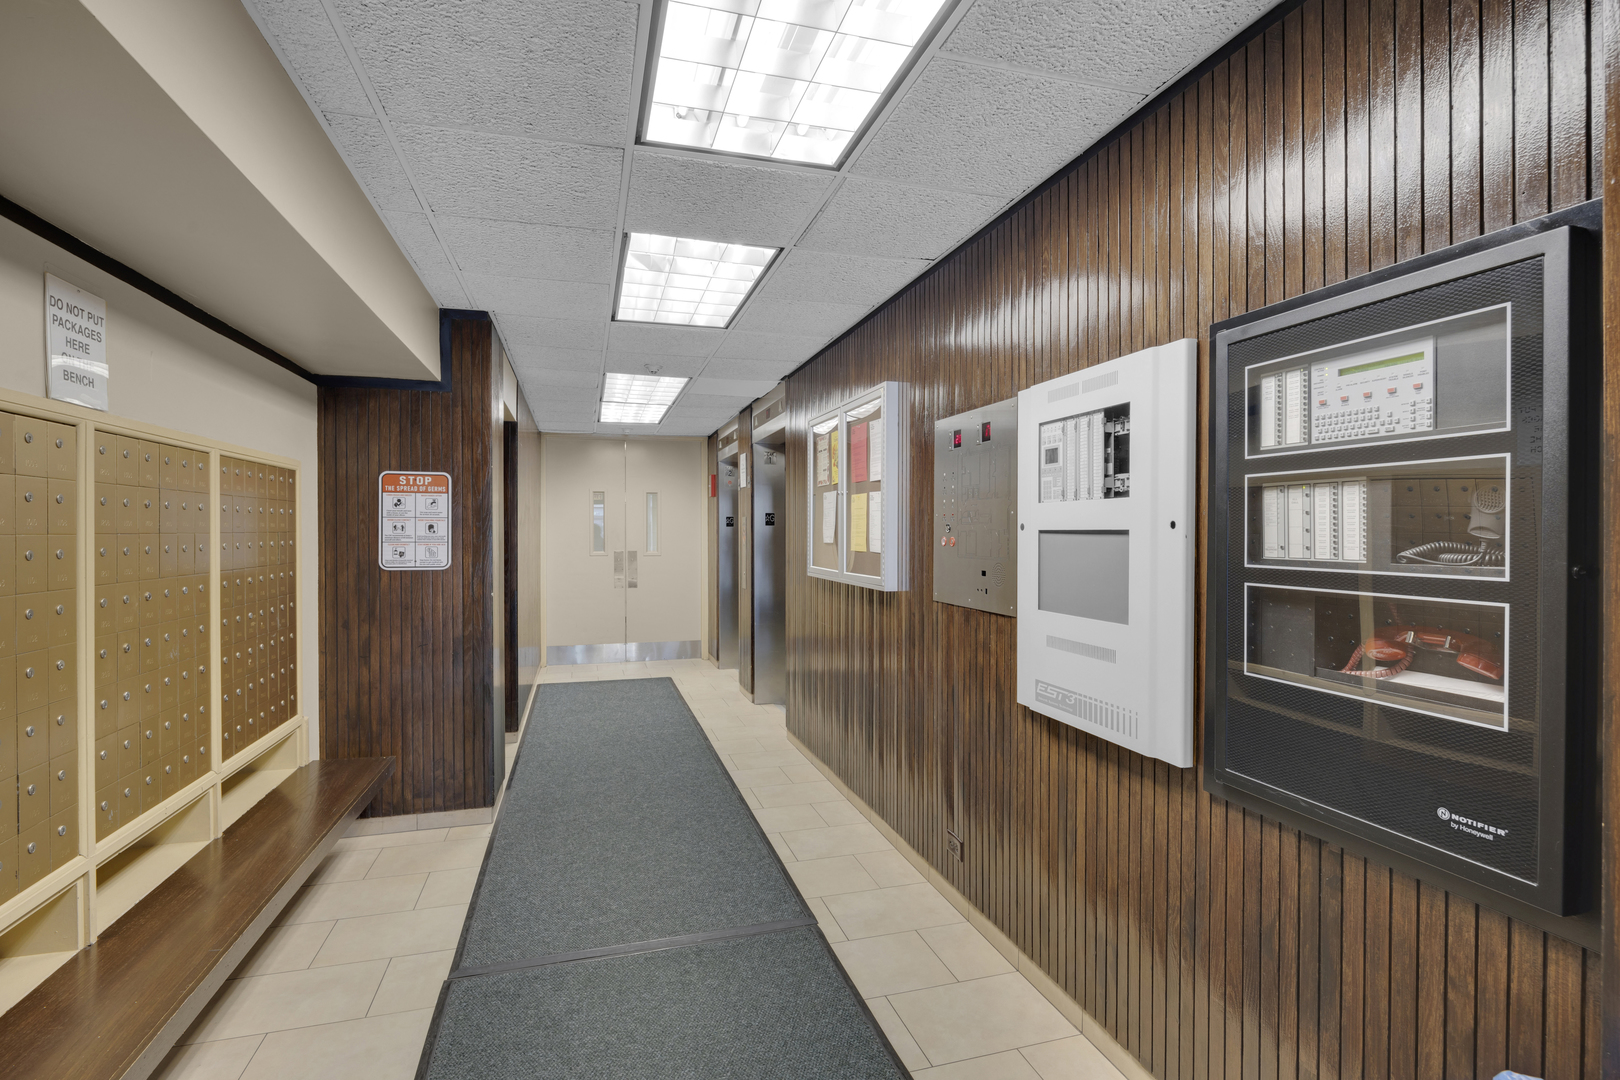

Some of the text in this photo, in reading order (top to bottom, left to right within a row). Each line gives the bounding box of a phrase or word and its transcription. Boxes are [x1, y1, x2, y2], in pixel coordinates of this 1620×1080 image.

[49, 295, 105, 328] DO NOT PUT
[52, 313, 102, 343] PACKAGES
[65, 336, 91, 355] HERE
[63, 368, 95, 388] BENCH
[399, 475, 432, 485] STOP
[1450, 821, 1494, 841] by Honeywell
[1451, 813, 1506, 837] NOTIFIER
